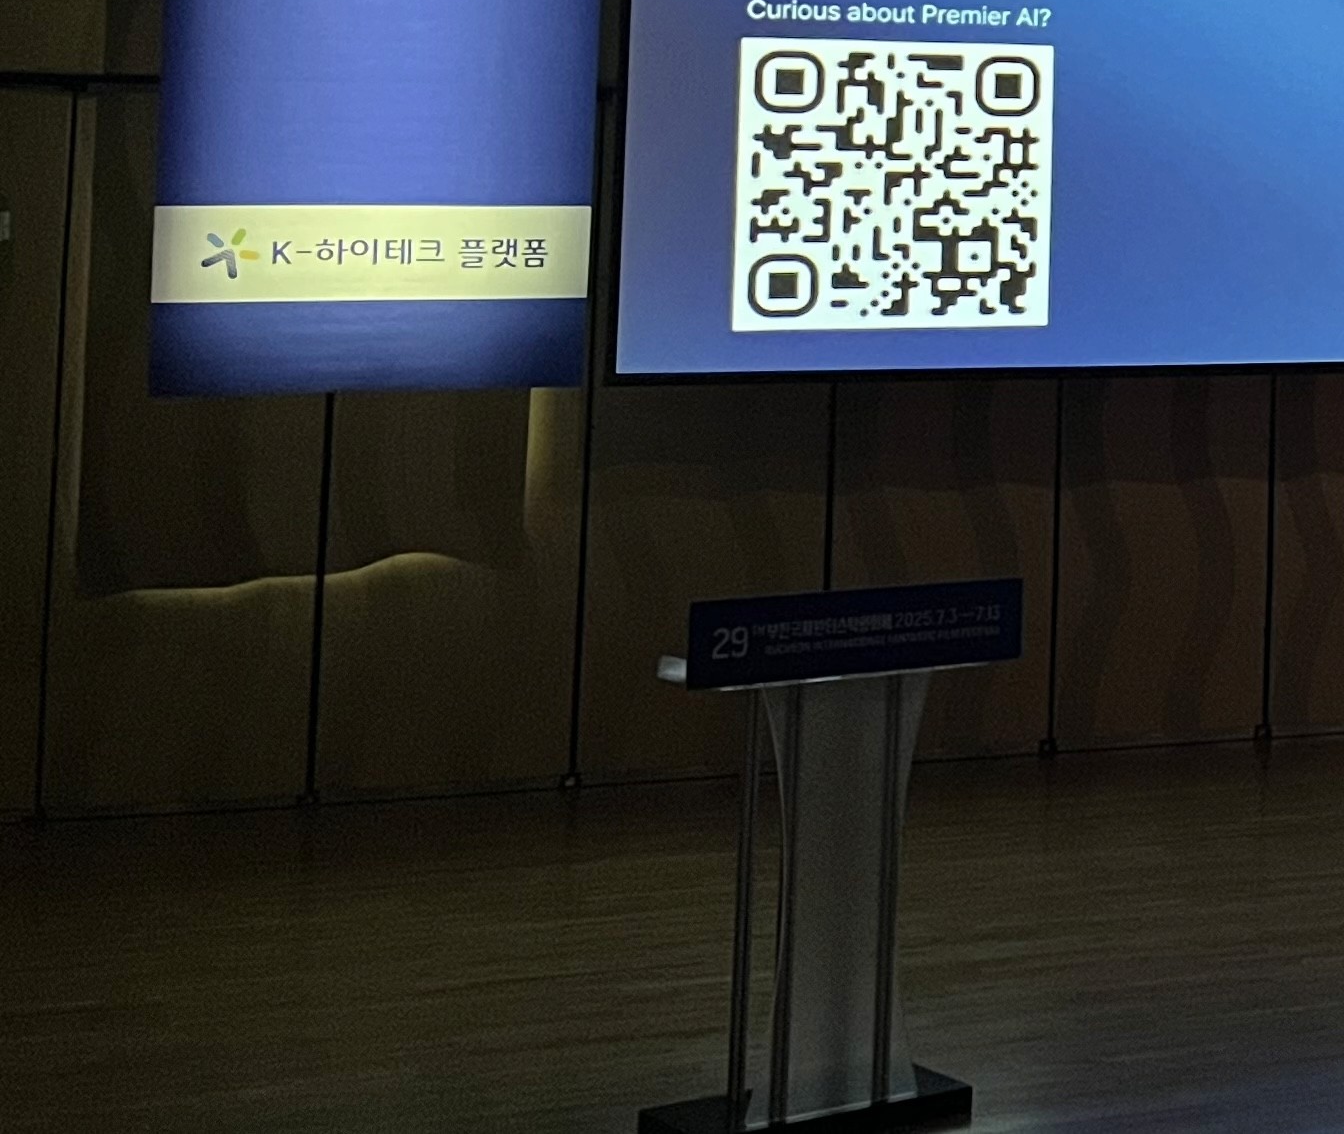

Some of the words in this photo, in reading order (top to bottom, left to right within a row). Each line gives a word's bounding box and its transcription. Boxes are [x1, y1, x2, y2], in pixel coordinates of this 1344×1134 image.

[847, 2, 915, 24] about
[922, 4, 1010, 27] Premier
[1016, 8, 1053, 28] AI?
[271, 238, 446, 266] K-하이테크
[457, 238, 549, 269] 플랫폼
